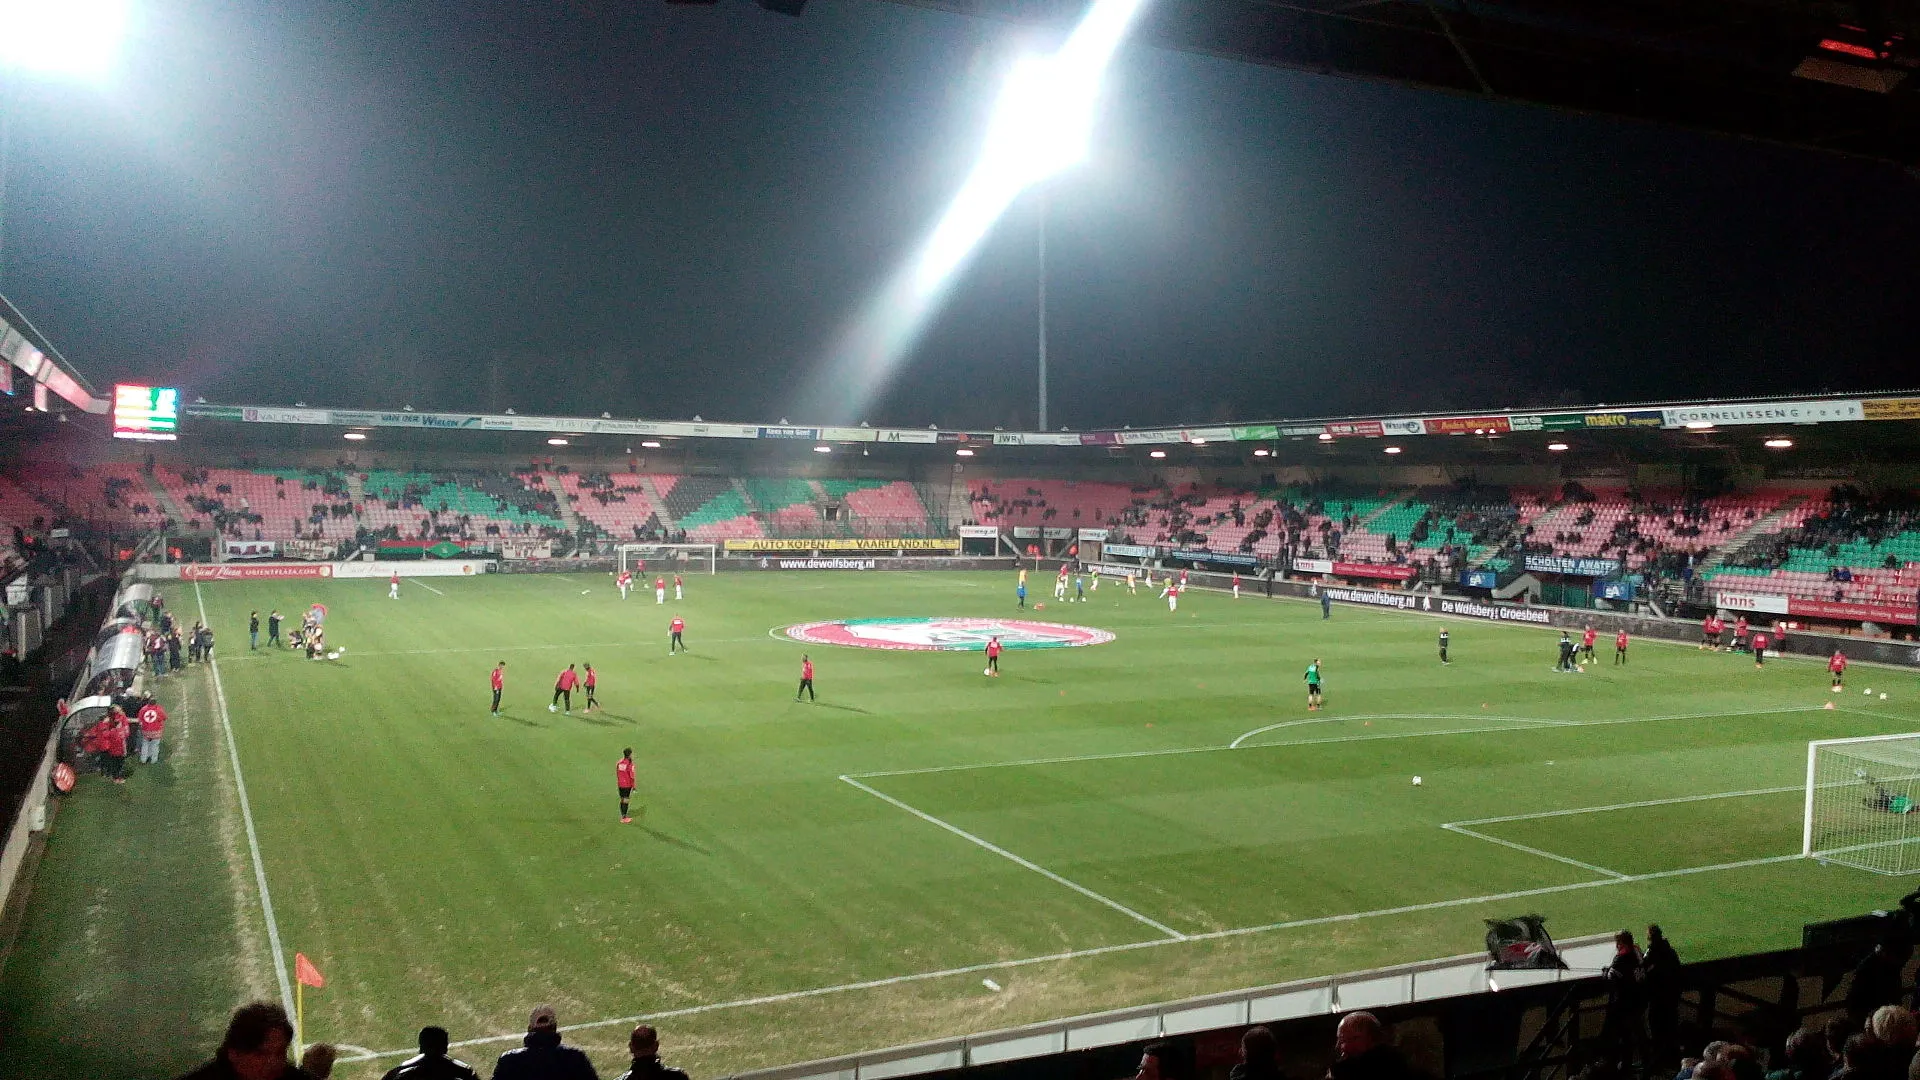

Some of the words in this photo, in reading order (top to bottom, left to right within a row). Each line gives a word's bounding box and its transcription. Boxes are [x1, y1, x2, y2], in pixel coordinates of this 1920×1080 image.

[1585, 414, 1628, 426] makro
[1679, 409, 1786, 421] CORNELISSEN
[752, 541, 785, 549] AUTO
[855, 539, 937, 549] VAARTLAND.NL
[779, 558, 875, 571] www.dewolfsberg.nl
[1525, 555, 1575, 568] SCHOLTEN
[1327, 588, 1416, 609] www.dewolfsberg.nl
[1441, 600, 1455, 613] De
[1500, 606, 1550, 623] Groesbeek
